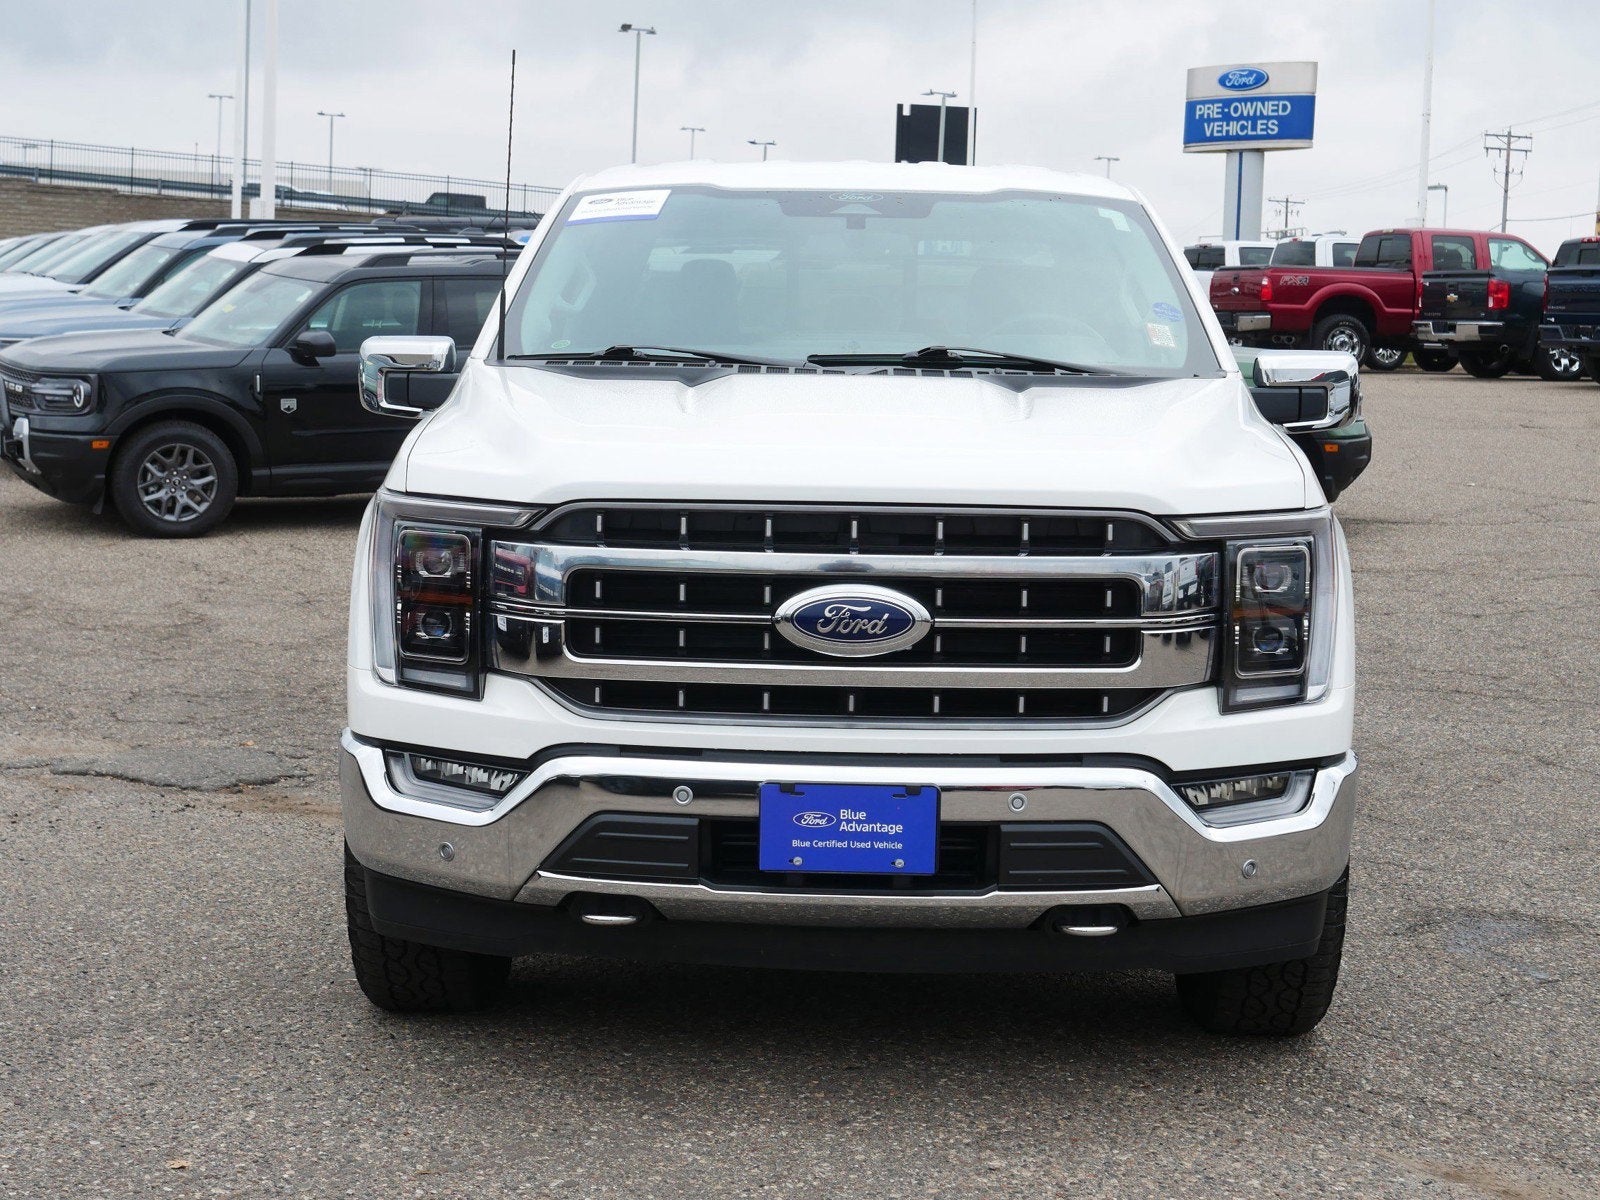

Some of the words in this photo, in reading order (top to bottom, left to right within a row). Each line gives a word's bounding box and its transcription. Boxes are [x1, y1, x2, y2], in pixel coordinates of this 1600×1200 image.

[1225, 70, 1257, 86] Ford
[1195, 101, 1292, 119] PRE-OWNED
[1204, 119, 1279, 137] VEHICLES
[839, 192, 874, 201] Ford
[816, 603, 889, 635] Ford
[801, 814, 829, 826] Ford
[839, 809, 867, 820] Blue
[839, 822, 903, 835] Advantage
[792, 839, 811, 848] Blue
[812, 839, 848, 848] Certified
[850, 840, 871, 849] Used
[873, 841, 903, 850] Vehicle
